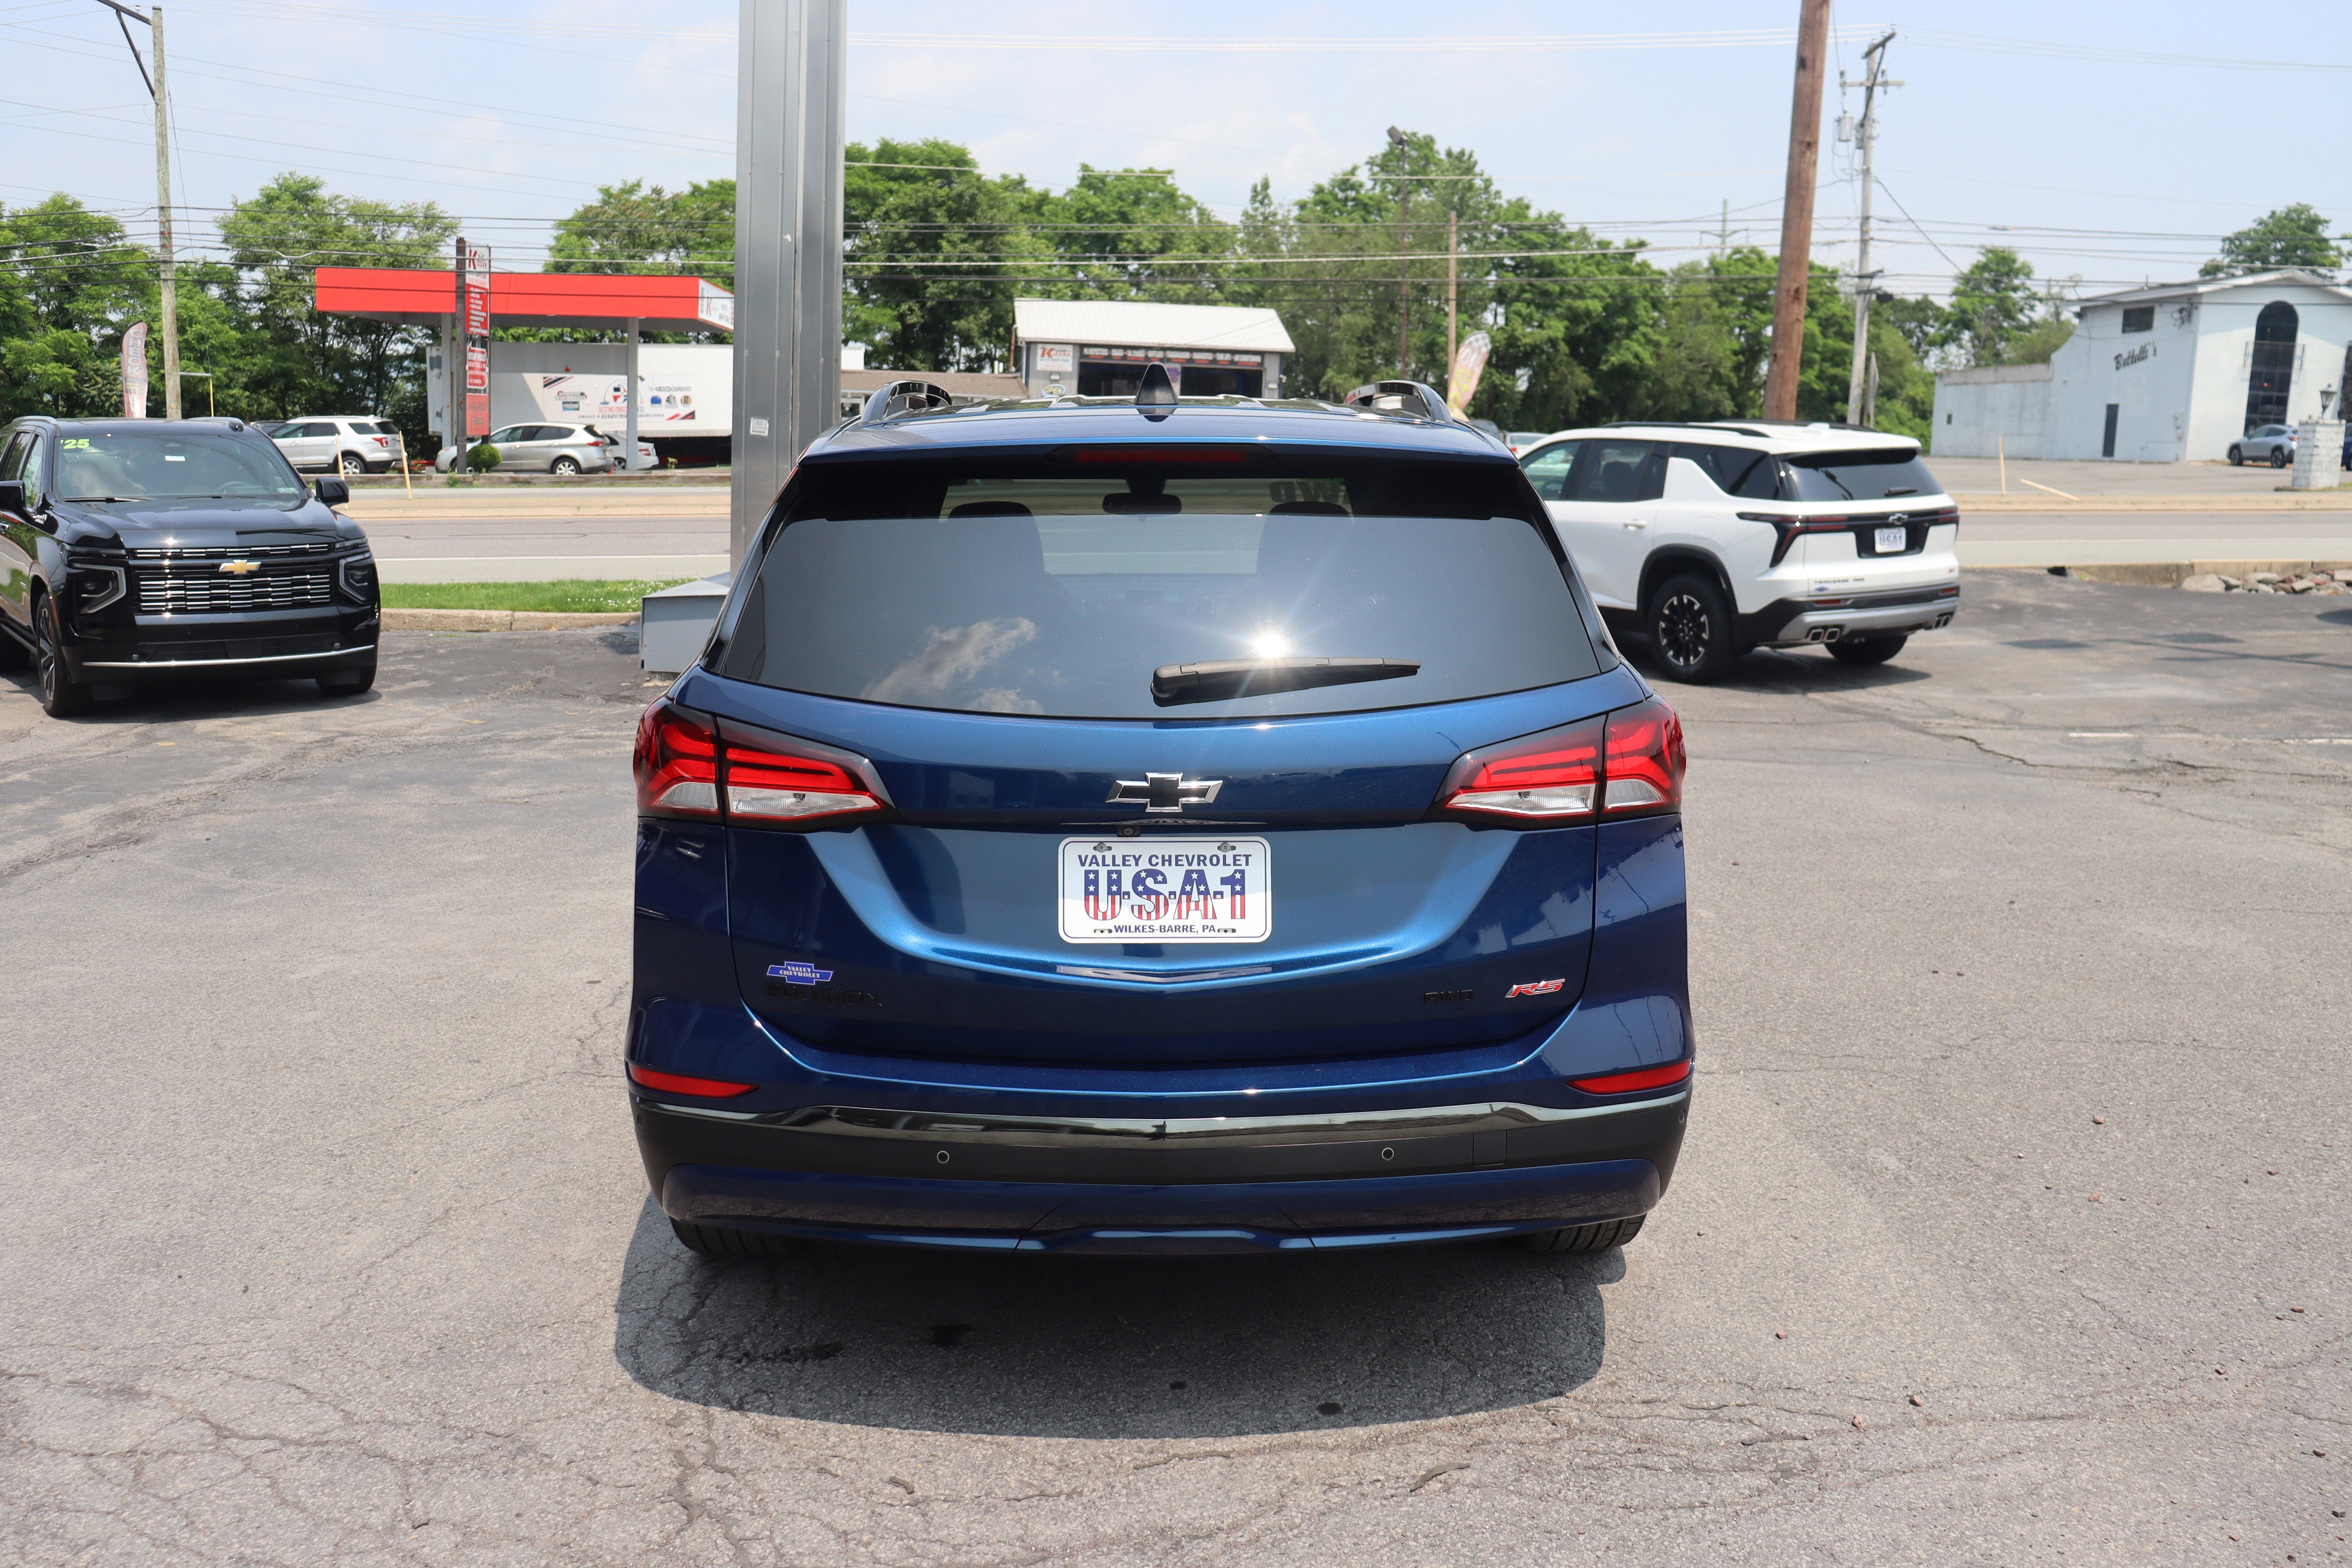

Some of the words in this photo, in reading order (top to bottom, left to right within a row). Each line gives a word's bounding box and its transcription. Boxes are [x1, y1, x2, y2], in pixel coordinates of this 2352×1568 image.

[127, 329, 143, 376] CHECK
[1045, 386, 1062, 395] OPEN
[1078, 855, 1143, 866] VALLEY
[1148, 854, 1252, 866] CHEVROLET
[1114, 925, 1199, 934] WILKES-BARRE,
[1203, 925, 1216, 933] PA
[780, 970, 820, 978] CHEVROLET
[764, 983, 882, 1007] EQUINOX
[1423, 989, 1474, 1004] AWD
[1504, 978, 1566, 998] RS
